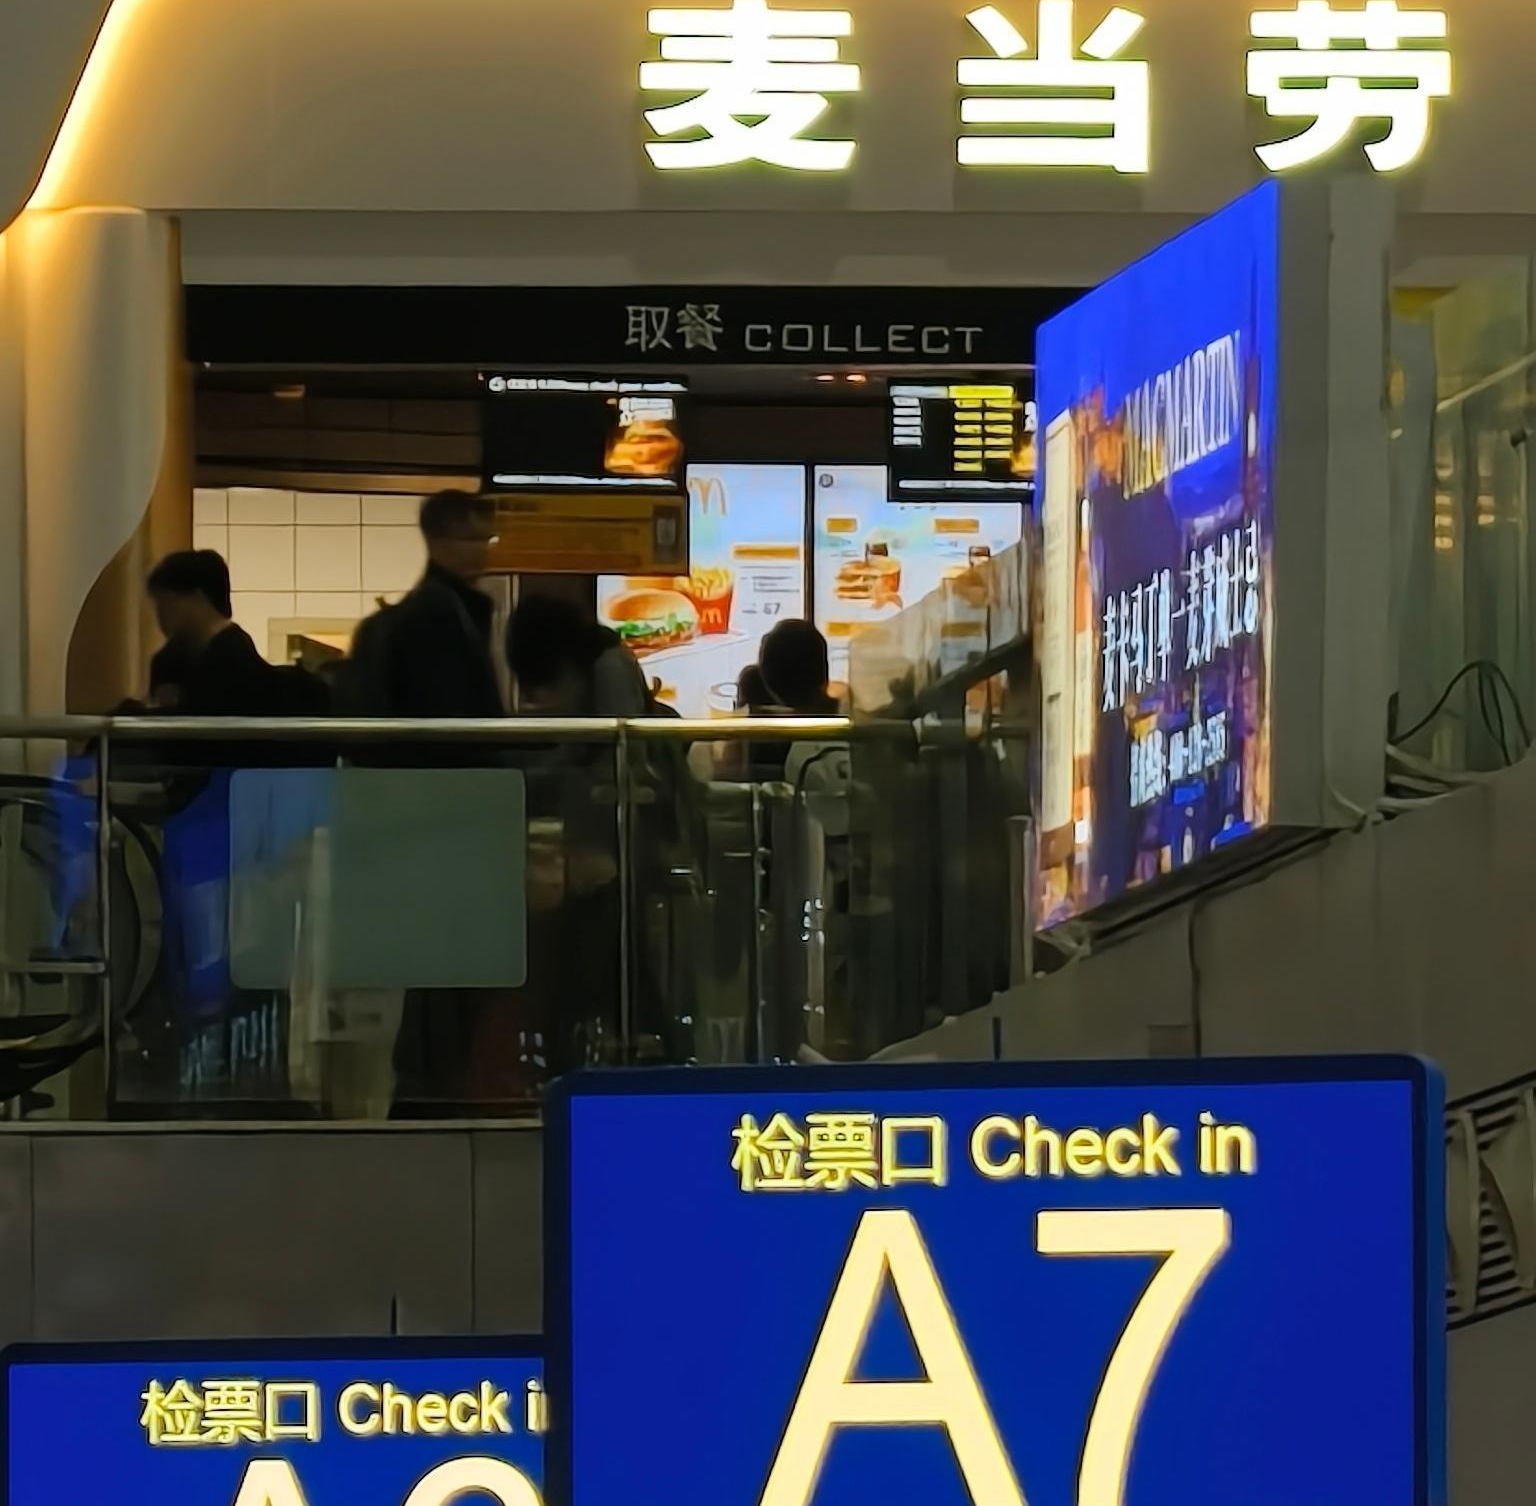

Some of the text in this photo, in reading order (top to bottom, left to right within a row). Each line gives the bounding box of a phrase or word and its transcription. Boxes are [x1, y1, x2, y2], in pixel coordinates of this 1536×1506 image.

[626, 304, 982, 353] 取餐 COLLECT
[732, 1111, 1254, 1191] 检票口 Check in
[140, 1380, 320, 1446] 检票口
[339, 1380, 512, 1436] Check
